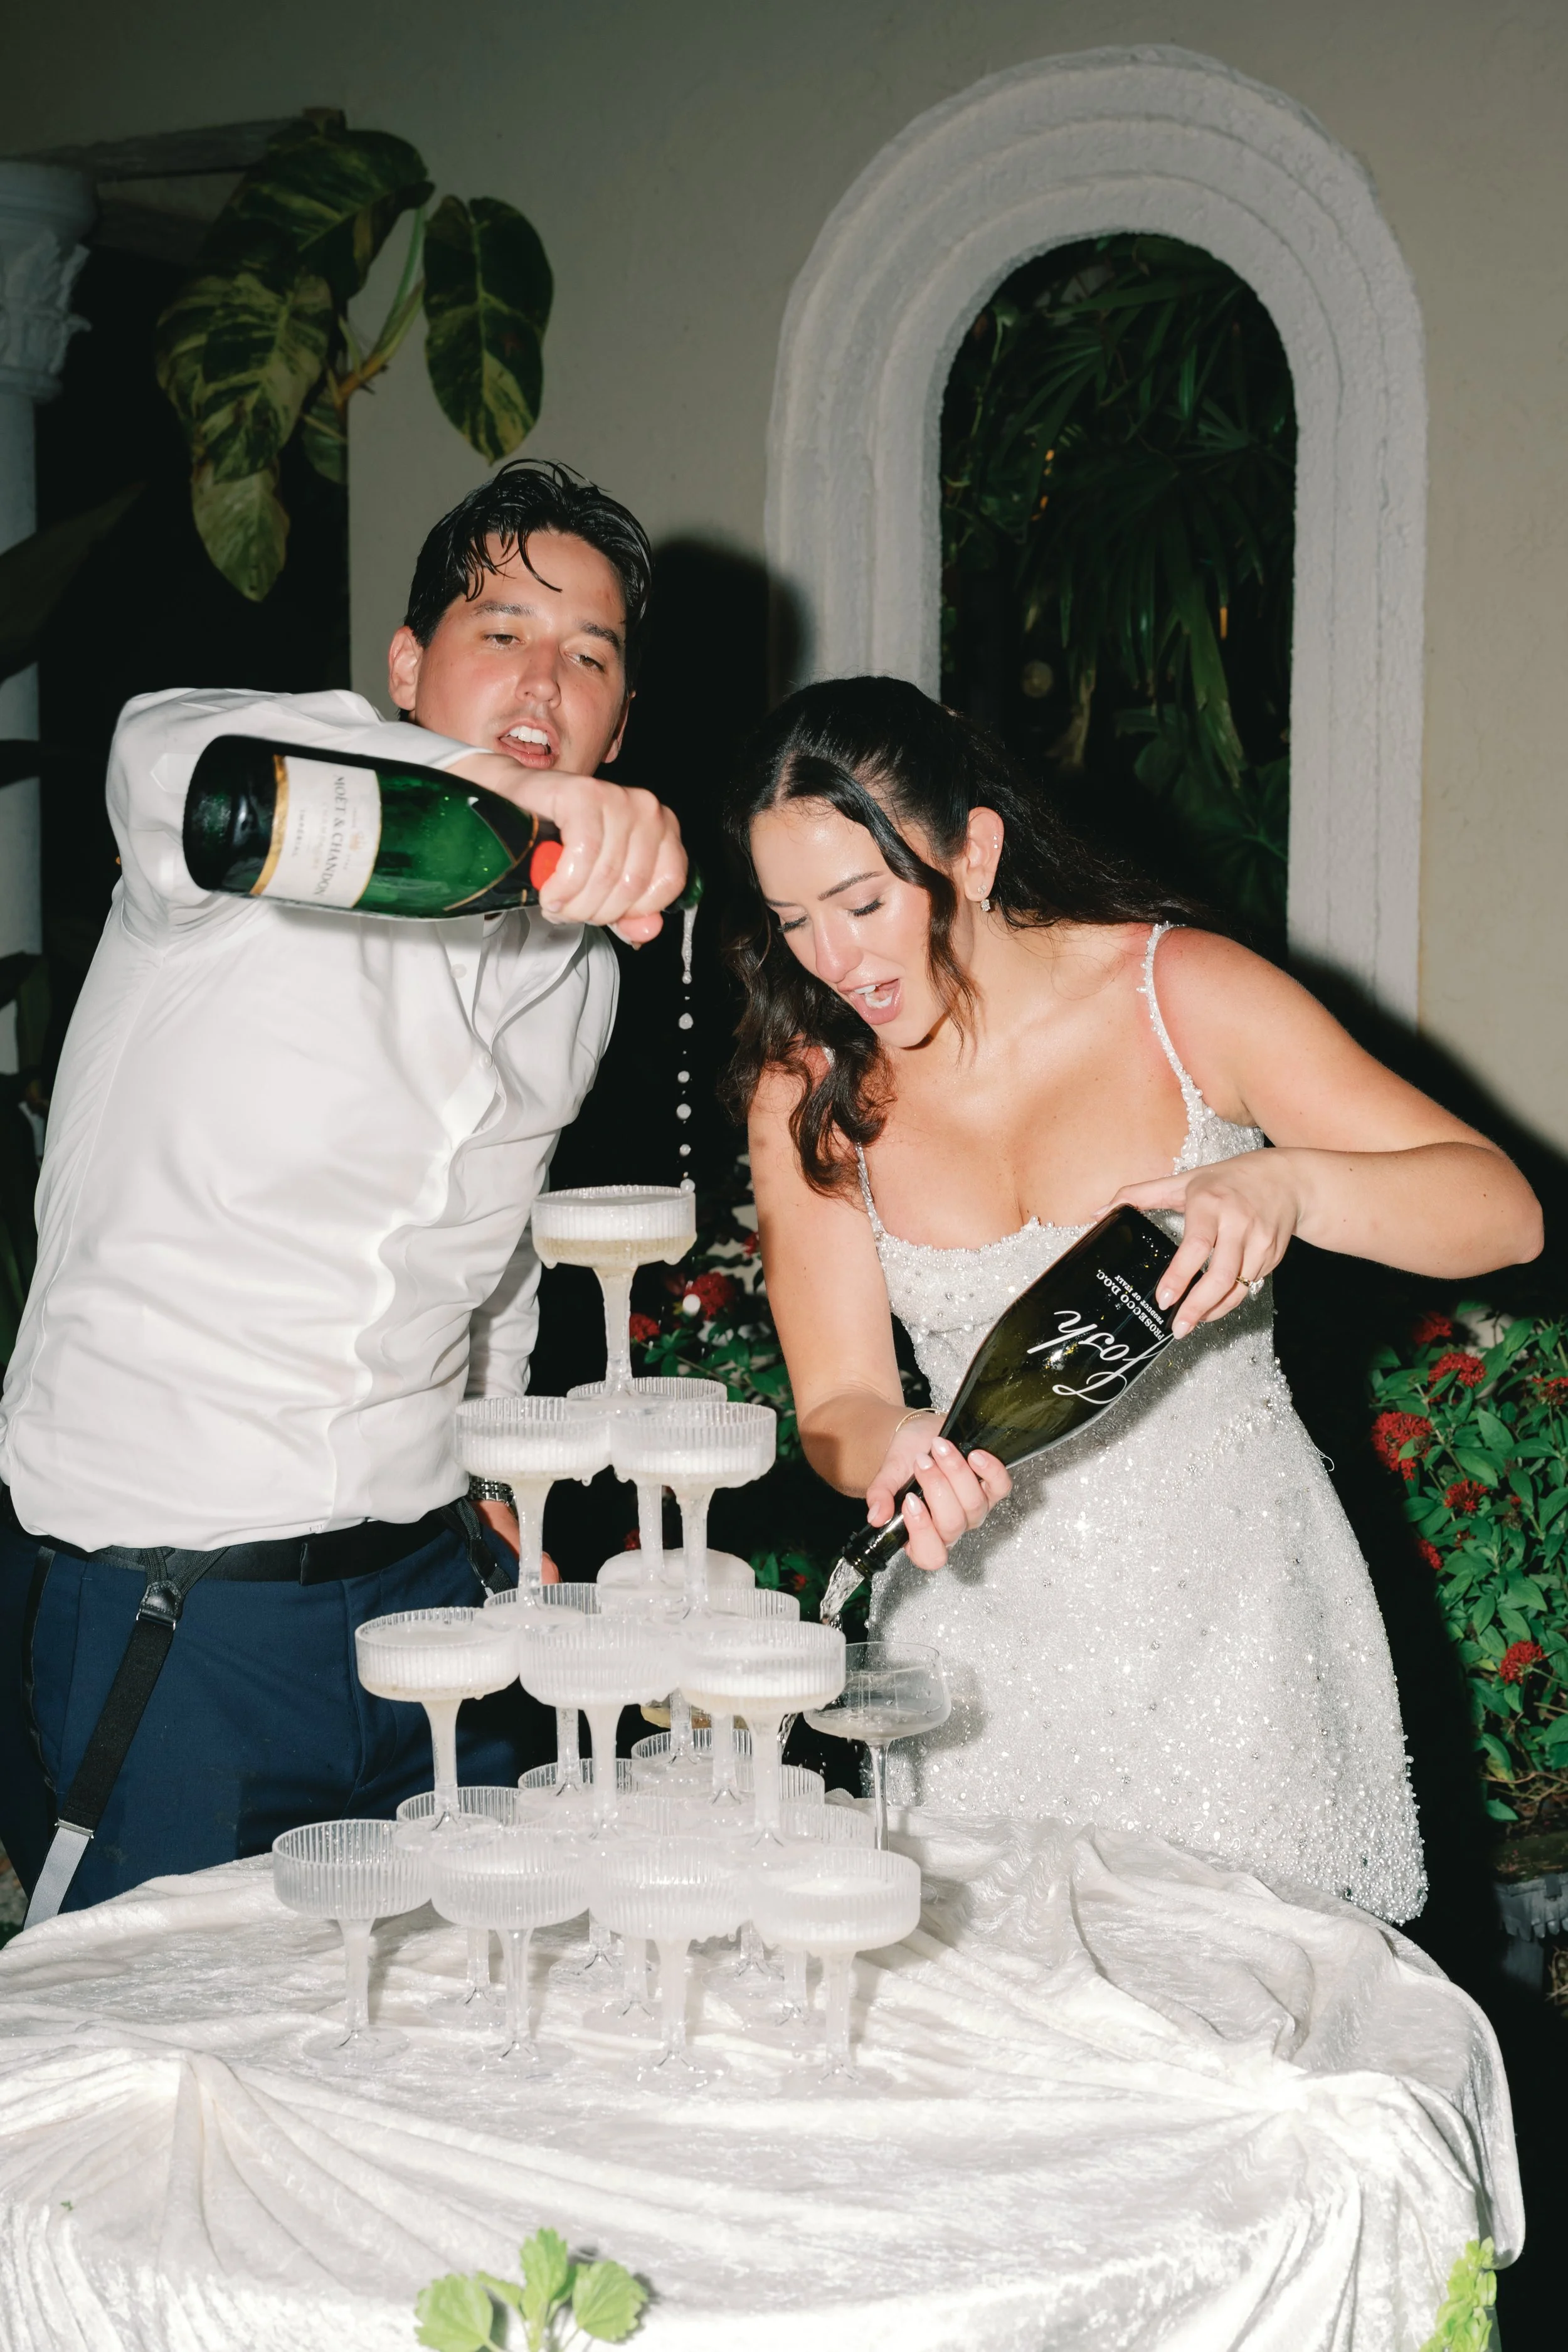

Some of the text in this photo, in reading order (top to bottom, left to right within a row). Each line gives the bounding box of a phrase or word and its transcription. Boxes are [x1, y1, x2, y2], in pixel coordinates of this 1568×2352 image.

[314, 774, 348, 896] MOËT & CHANDON
[1096, 1269, 1165, 1341] PROSECCO D.O.C.
[1114, 1274, 1165, 1325] PRODUCT OF ITALY
[1027, 1310, 1174, 1404] Josh
